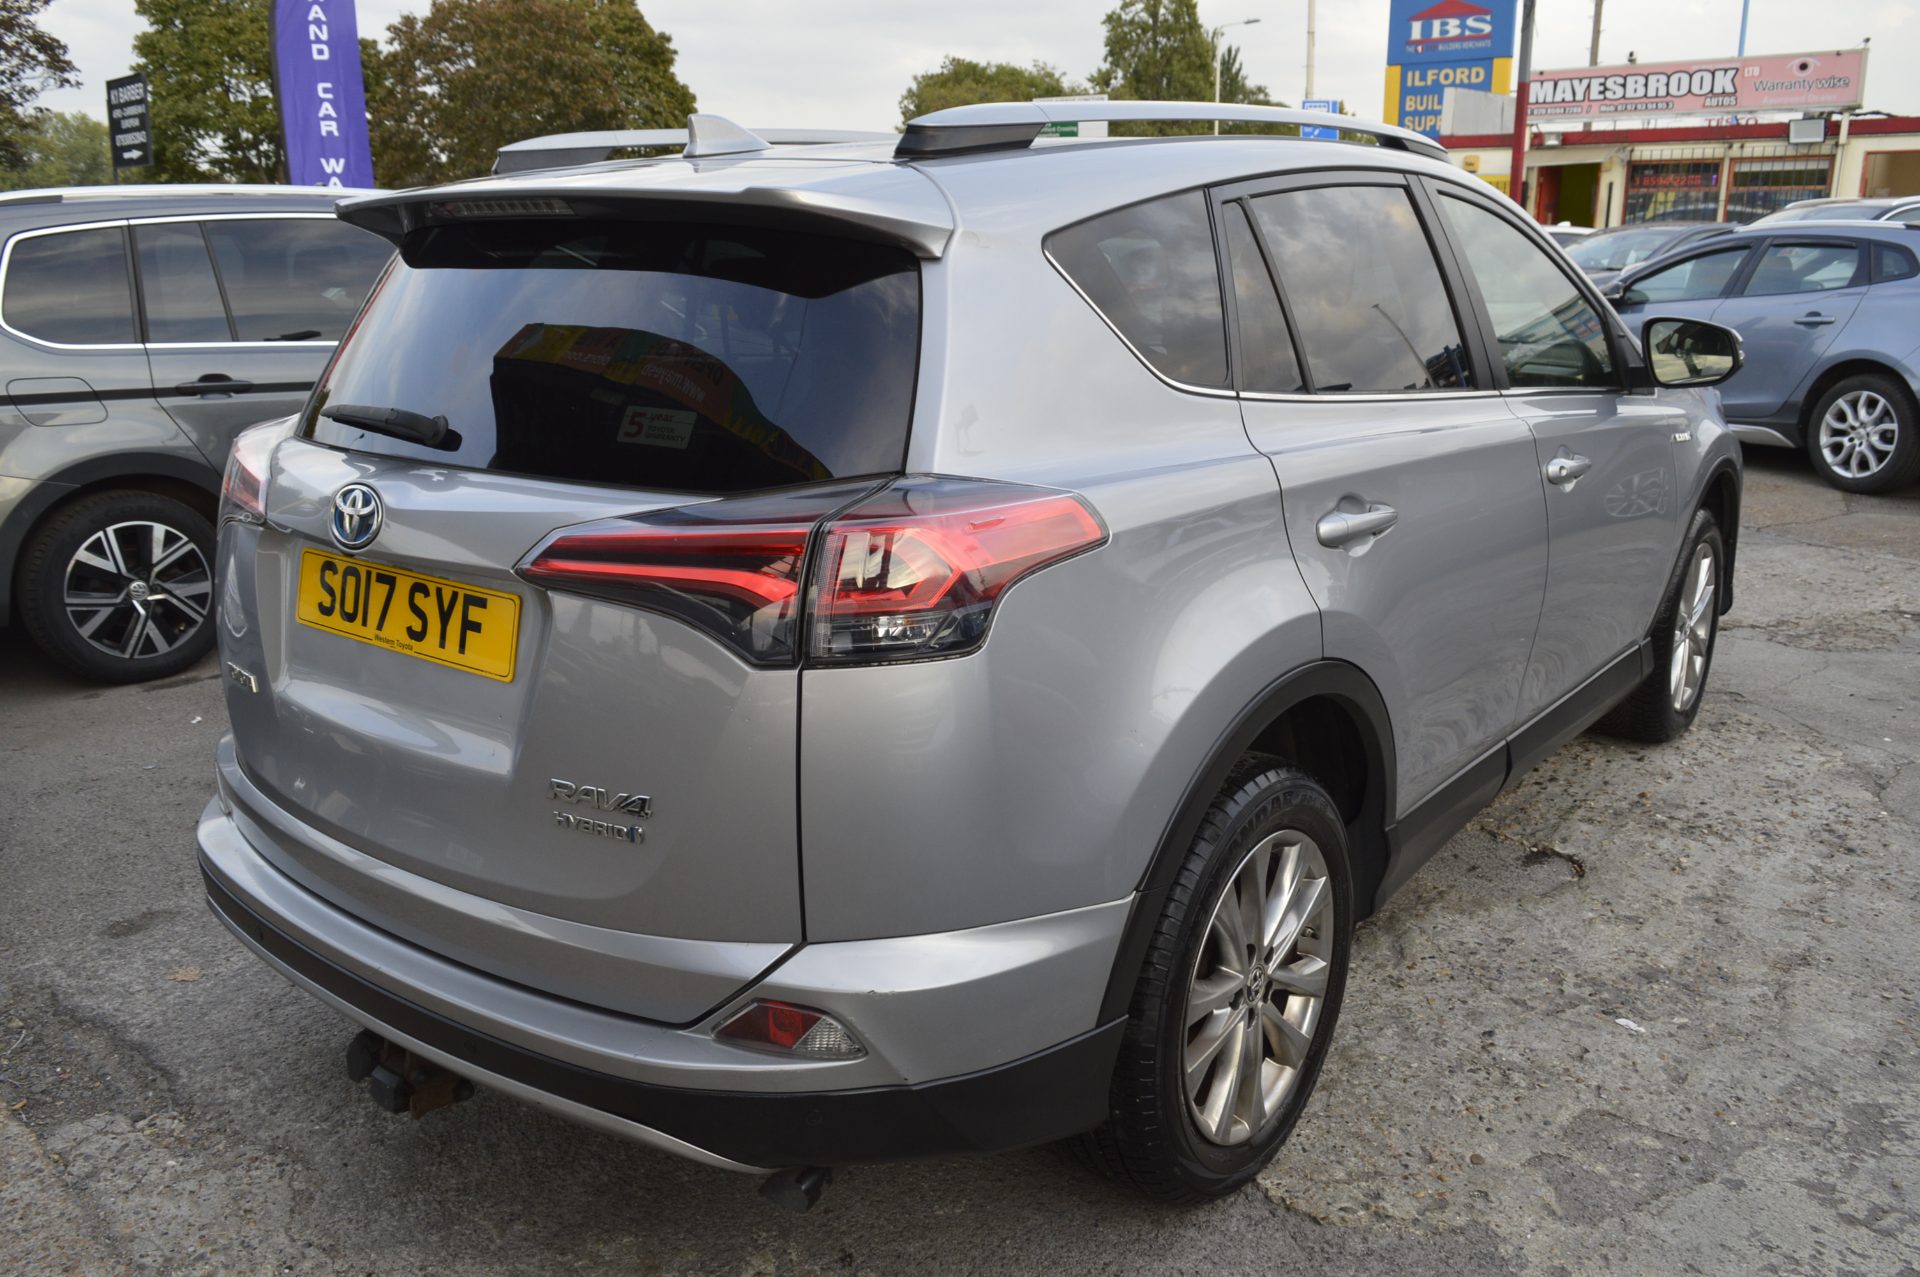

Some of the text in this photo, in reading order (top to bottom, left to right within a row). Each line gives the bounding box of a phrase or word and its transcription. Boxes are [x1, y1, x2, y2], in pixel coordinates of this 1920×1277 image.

[307, 0, 330, 61] AND
[1409, 14, 1493, 42] IBS
[1406, 66, 1485, 87] ILFORD
[1527, 67, 1739, 105] MAYESBROOK
[1744, 66, 1760, 78] LTD
[316, 82, 340, 137] CAR
[1703, 95, 1737, 107] AUTOS
[623, 411, 647, 438] 5
[317, 559, 489, 655] SO17 SYF
[396, 639, 414, 652] Toyota
[550, 777, 655, 820] RAV4
[552, 810, 628, 841] HYBRID
